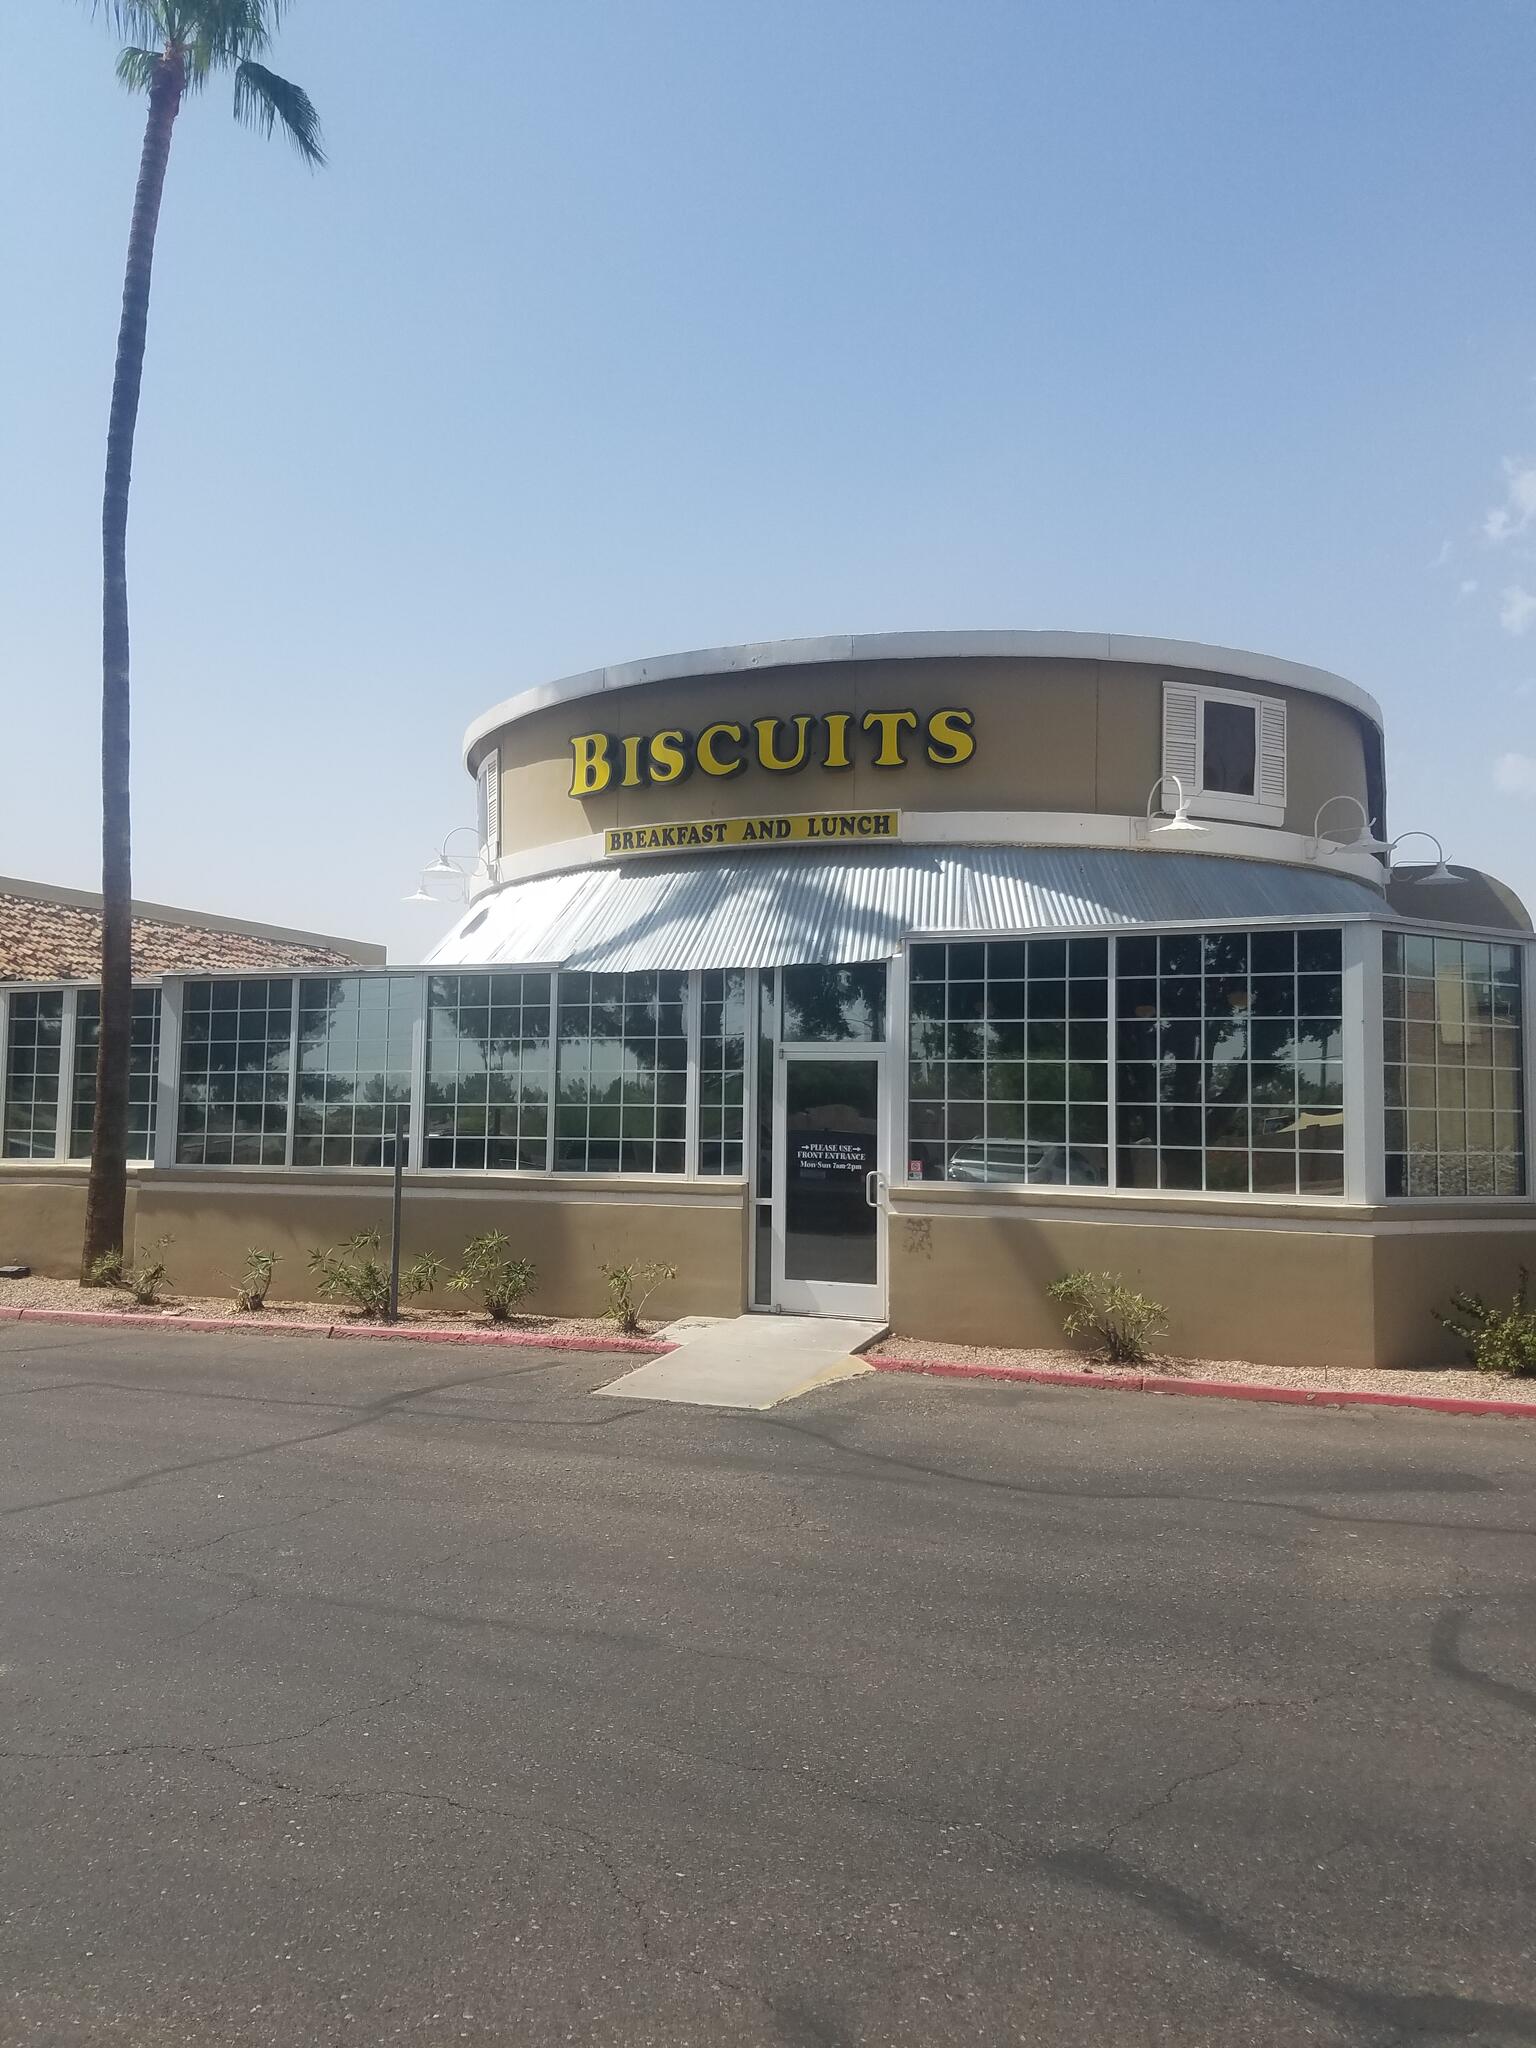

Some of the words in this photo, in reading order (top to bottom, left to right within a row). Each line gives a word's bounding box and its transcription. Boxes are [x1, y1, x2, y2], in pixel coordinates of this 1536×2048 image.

[569, 707, 976, 798] BISCUITS
[610, 824, 727, 851] BREAKFAST
[742, 819, 791, 840] AND
[807, 815, 890, 837] LUNCH
[797, 1151, 823, 1159] FRONT
[824, 1152, 866, 1161] ENTRANCE
[810, 1144, 838, 1152] PLEASE
